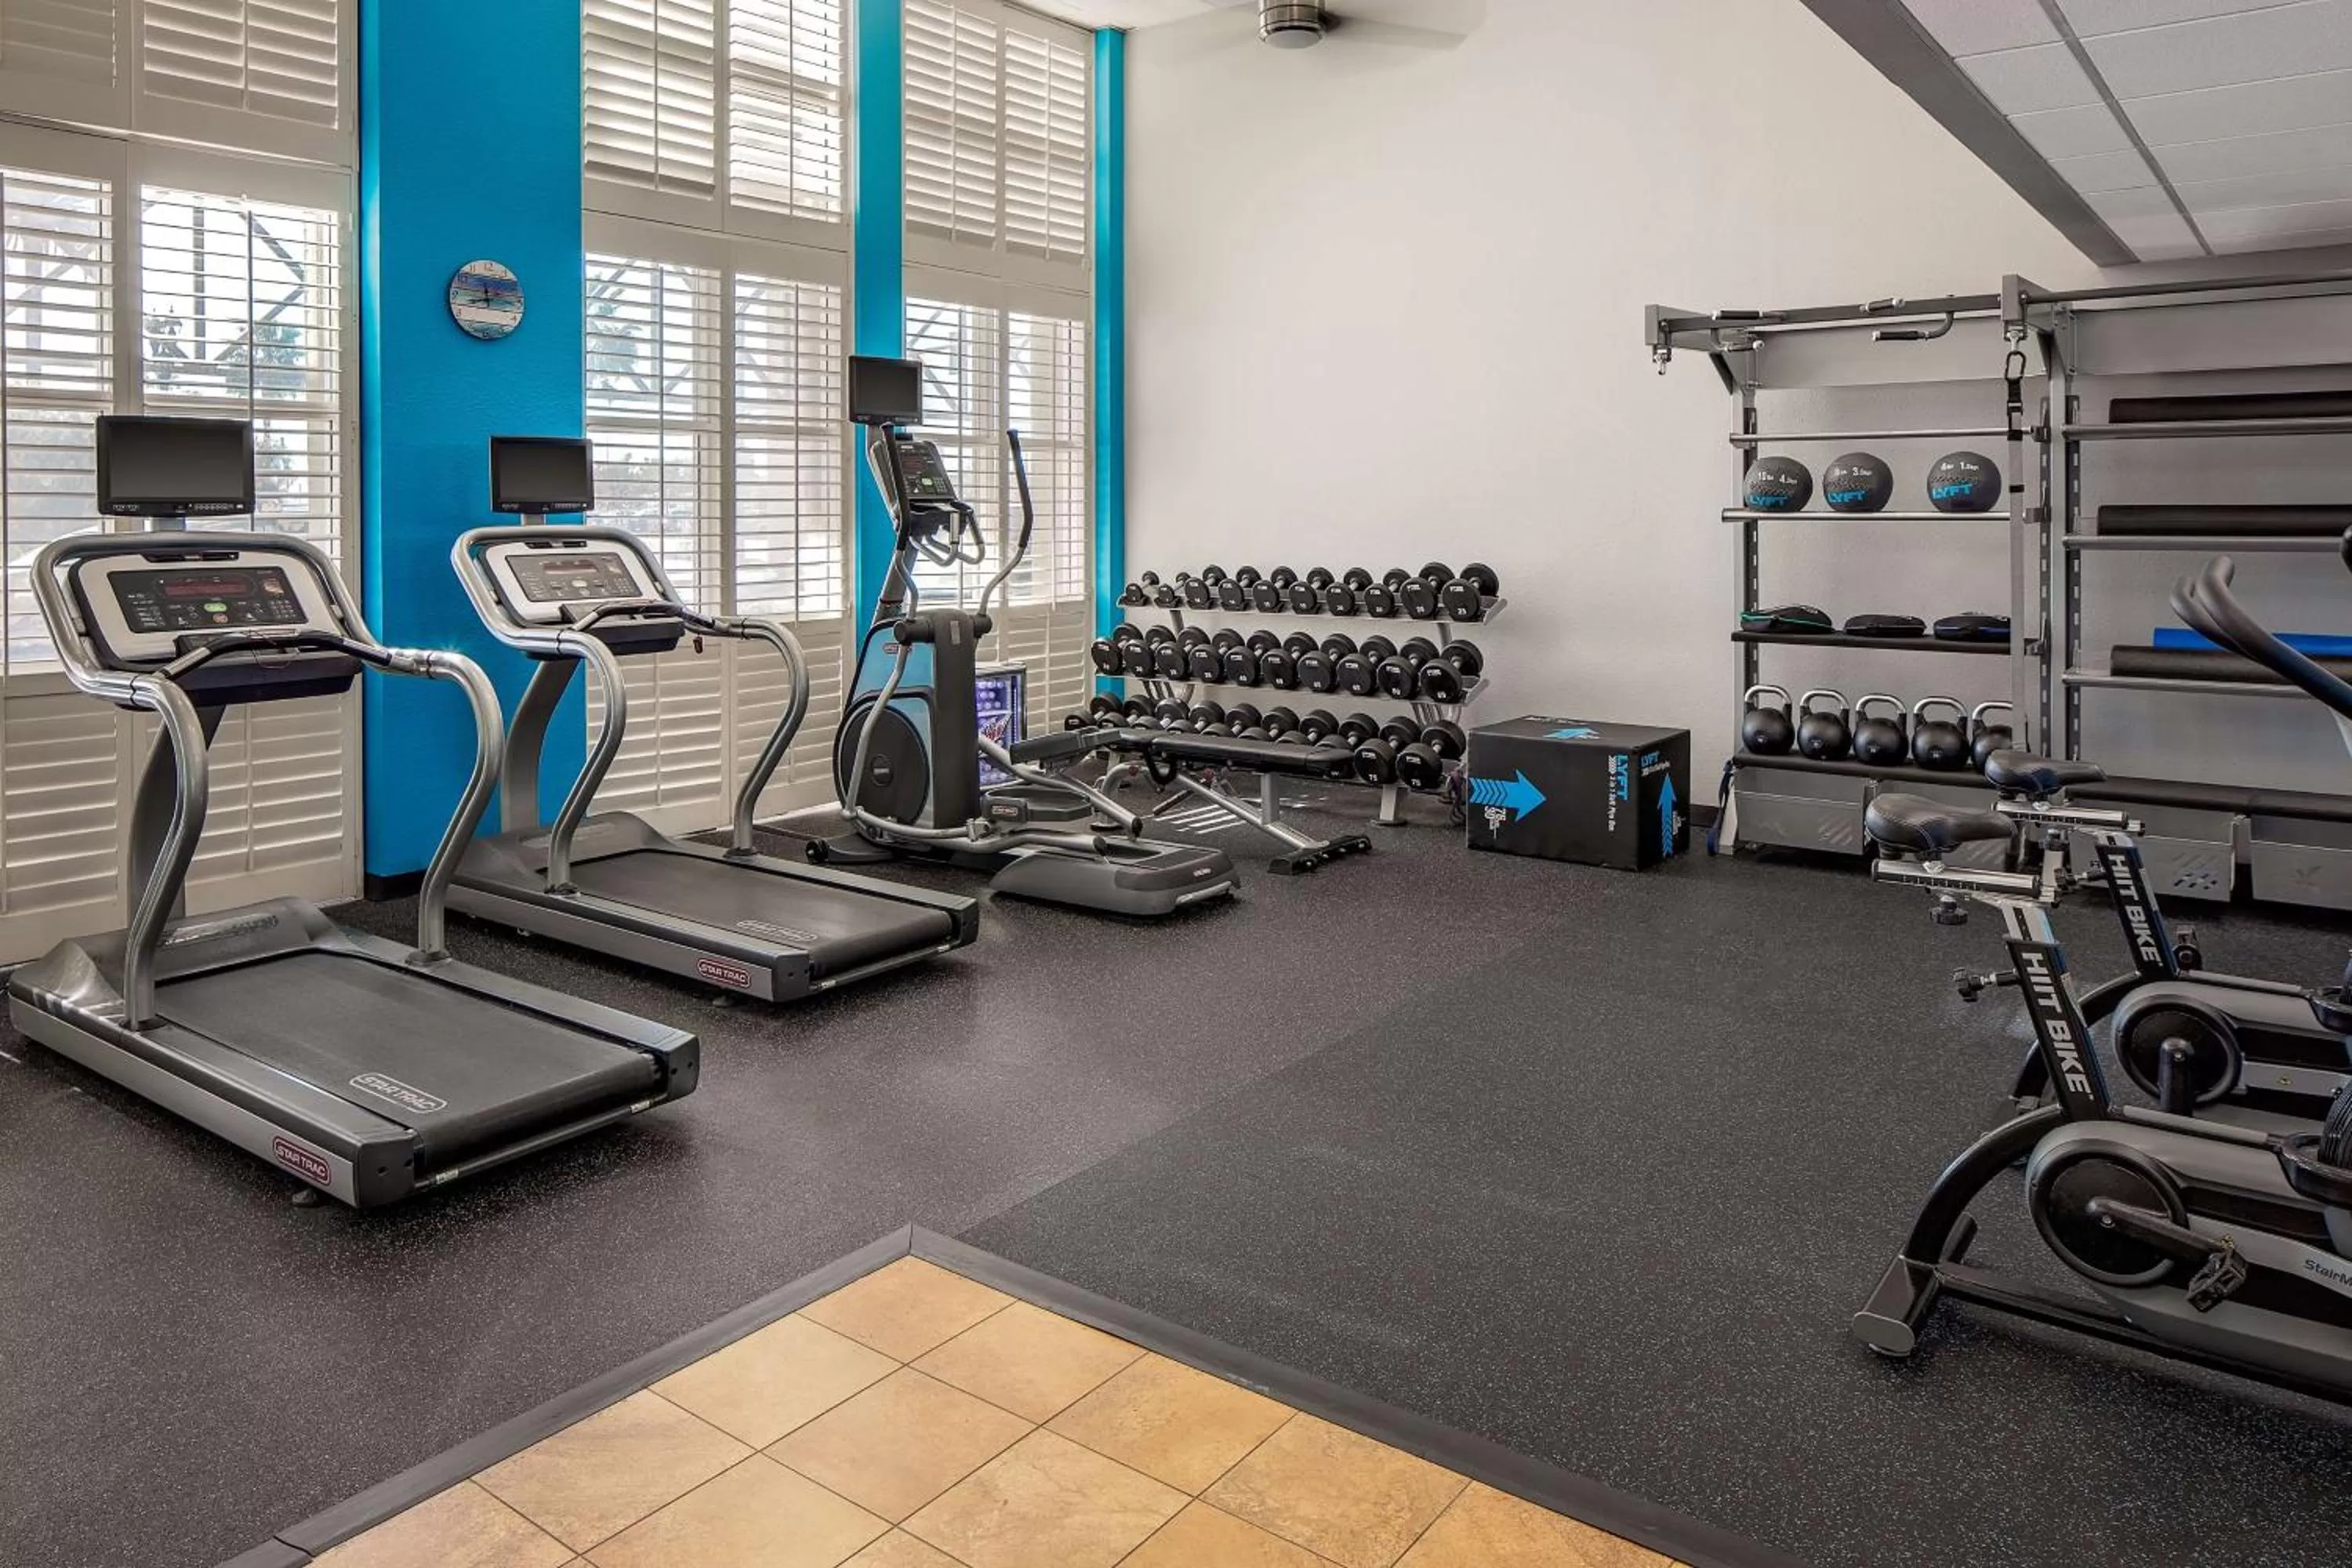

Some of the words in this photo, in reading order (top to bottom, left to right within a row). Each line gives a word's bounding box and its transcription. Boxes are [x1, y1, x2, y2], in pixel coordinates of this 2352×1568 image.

[1749, 495, 1788, 506] LYFT
[1828, 490, 1865, 503] LYFT
[1932, 483, 1973, 500] LYFT
[1641, 751, 1661, 768] LYFT
[1617, 754, 1628, 800] LYFT
[2107, 854, 2140, 901] HIIT
[2125, 906, 2161, 963] BIKE
[699, 964, 722, 976] STAR
[724, 969, 746, 982] TRAC
[2021, 953, 2063, 1013] HIIT
[2045, 1019, 2092, 1093] BIKE
[358, 1076, 400, 1094] STAR
[394, 1090, 437, 1109] TRAC
[276, 1145, 300, 1165] STAR
[300, 1156, 325, 1177] TRAC
